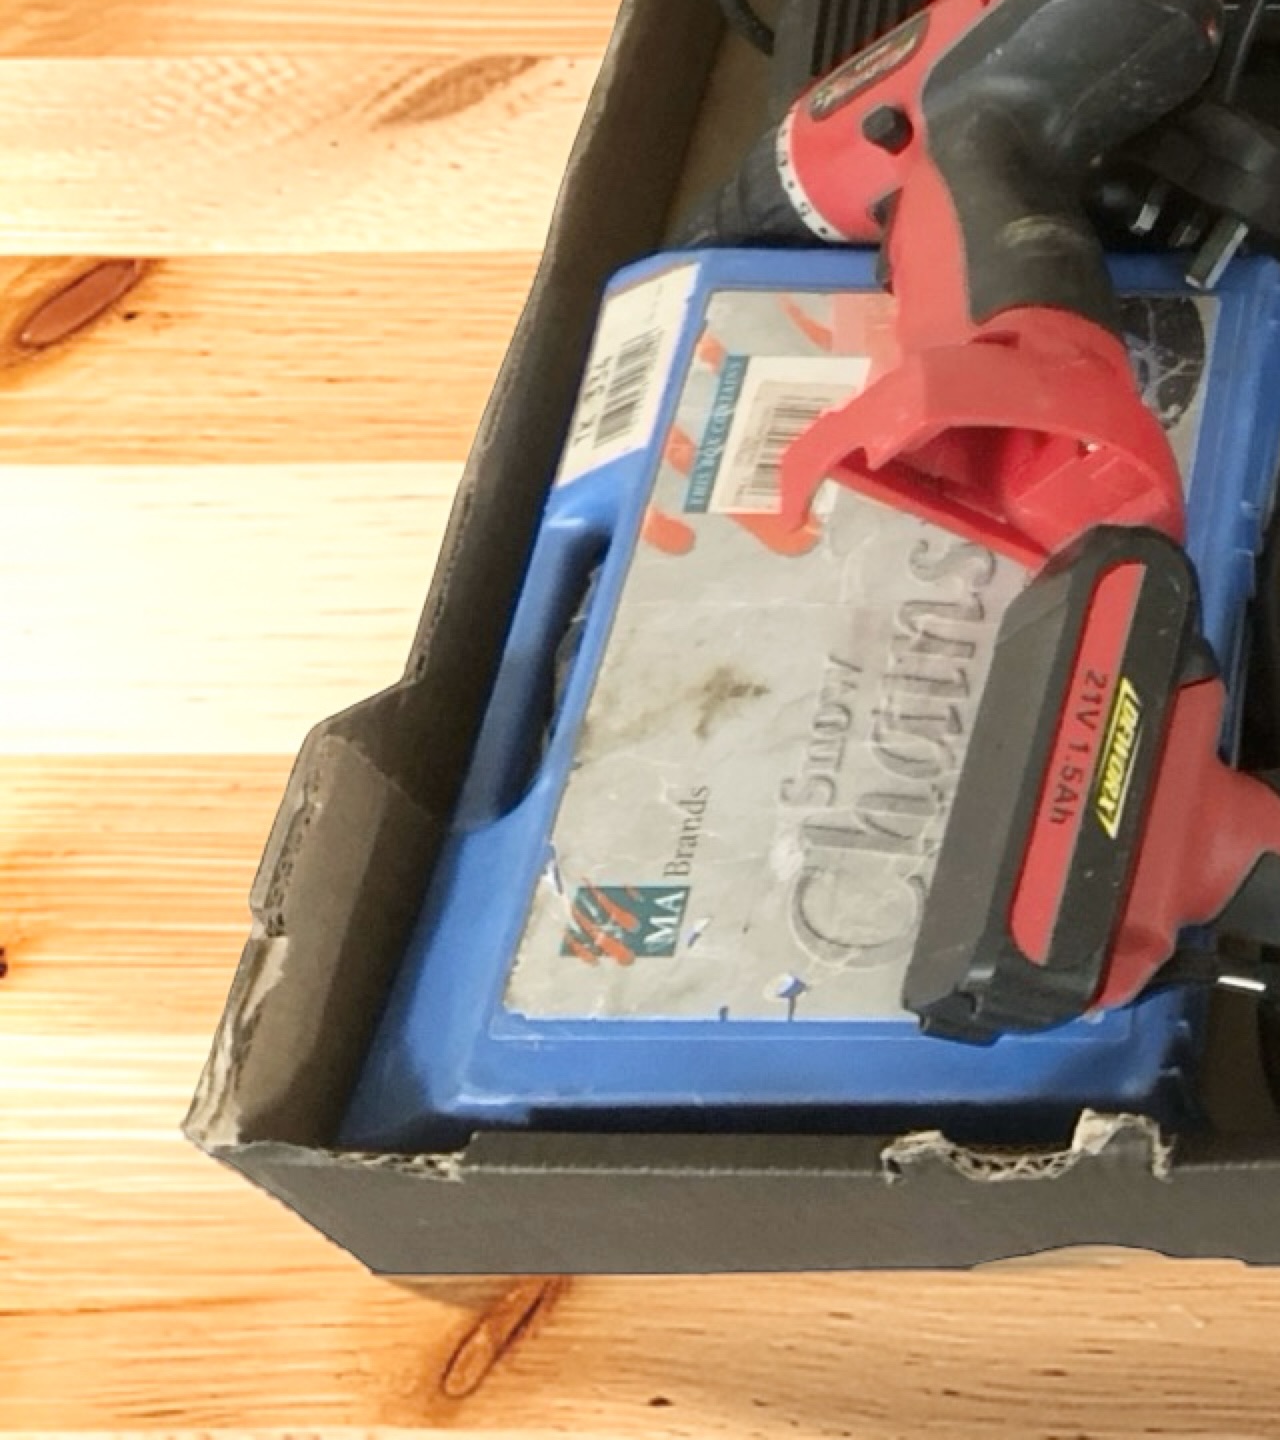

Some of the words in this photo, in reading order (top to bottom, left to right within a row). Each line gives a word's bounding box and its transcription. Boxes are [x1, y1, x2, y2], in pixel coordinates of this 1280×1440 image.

[780, 650, 863, 806] Snow
[789, 535, 998, 956] Chains
[1072, 668, 1108, 734] 21V
[1048, 742, 1091, 825] 1.5Ah
[663, 784, 709, 880] Brands
[644, 889, 686, 952] MA
